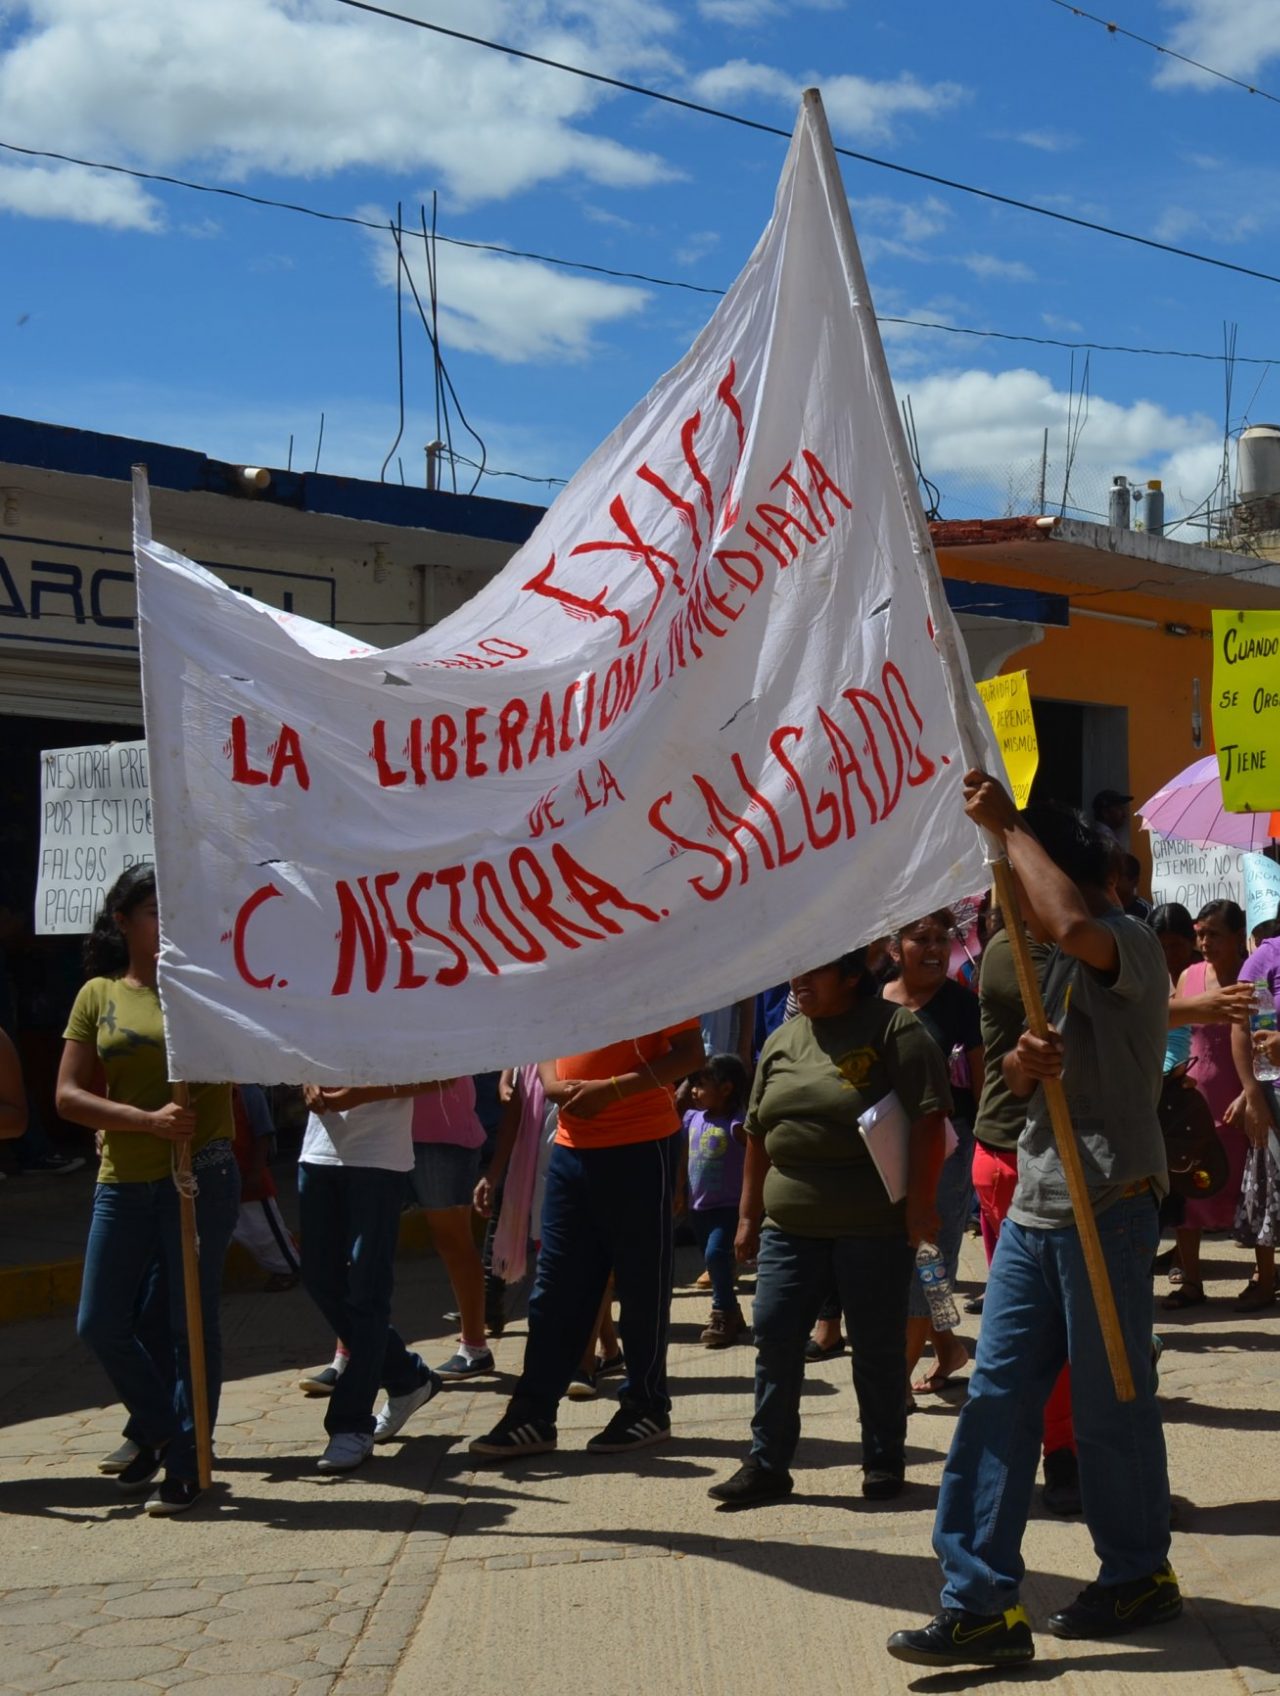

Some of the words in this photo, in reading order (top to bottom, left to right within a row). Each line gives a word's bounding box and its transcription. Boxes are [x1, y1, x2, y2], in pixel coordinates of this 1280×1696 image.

[230, 714, 310, 791] LA
[372, 640, 648, 788] LIBERACION
[1220, 691, 1239, 708] SE
[45, 750, 111, 790] NESTORA
[1221, 745, 1266, 781] TIENE
[527, 801, 566, 839] DE
[574, 760, 626, 813] LA
[45, 800, 72, 836] POR
[42, 847, 106, 882] FALSOS
[1214, 854, 1231, 876] NO
[228, 884, 288, 990] C.
